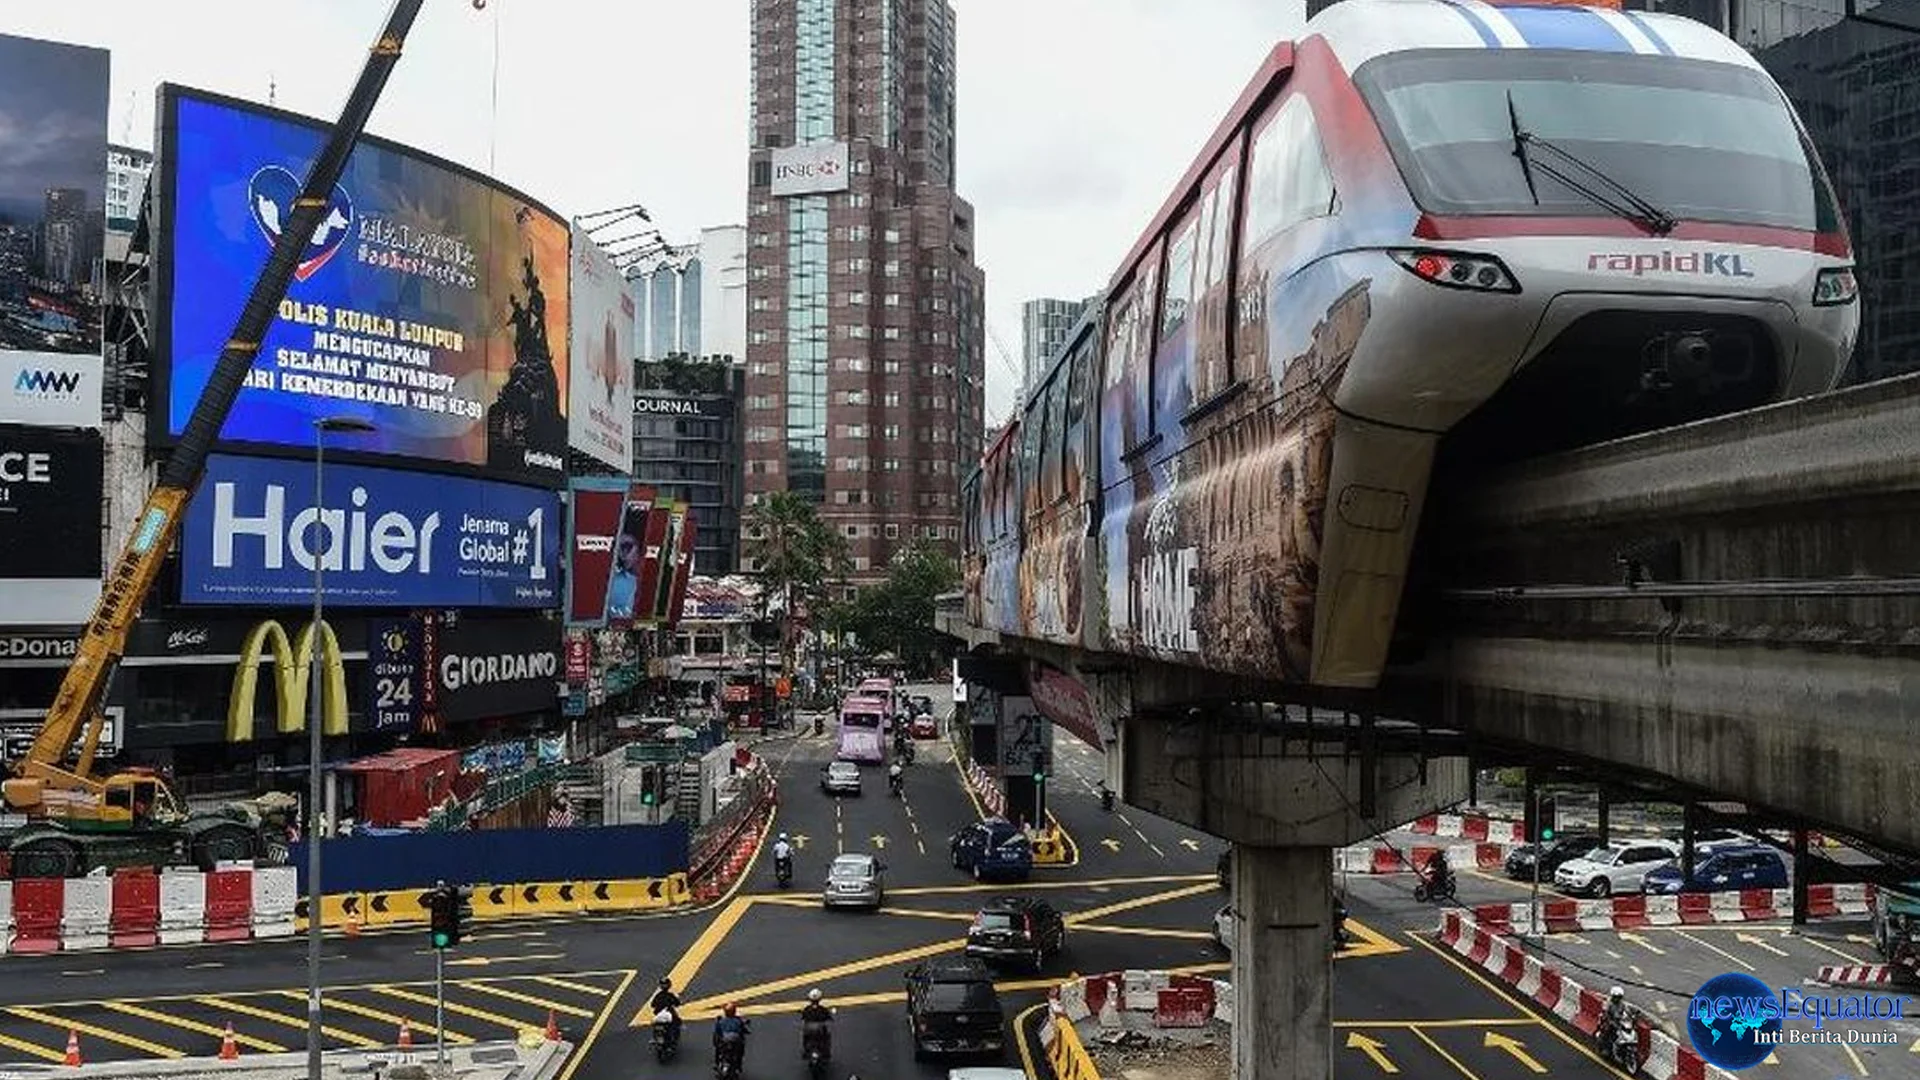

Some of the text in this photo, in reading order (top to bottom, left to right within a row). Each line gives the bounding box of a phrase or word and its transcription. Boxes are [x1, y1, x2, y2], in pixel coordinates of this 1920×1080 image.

[777, 163, 814, 179] HSBC
[1588, 250, 1754, 276] rapidKL
[277, 299, 464, 352] OLIS KUALA LUMPUR
[277, 348, 361, 377] SELAMAT
[313, 330, 431, 367] MENGUCAPKAN
[242, 368, 274, 390] ARI
[412, 390, 447, 413] YANG
[212, 482, 441, 574] Haier
[460, 513, 509, 536] Jenama
[460, 537, 509, 563] Global
[0, 637, 82, 656] cDona
[441, 652, 557, 690] GIORDANO
[377, 678, 413, 707] 24
